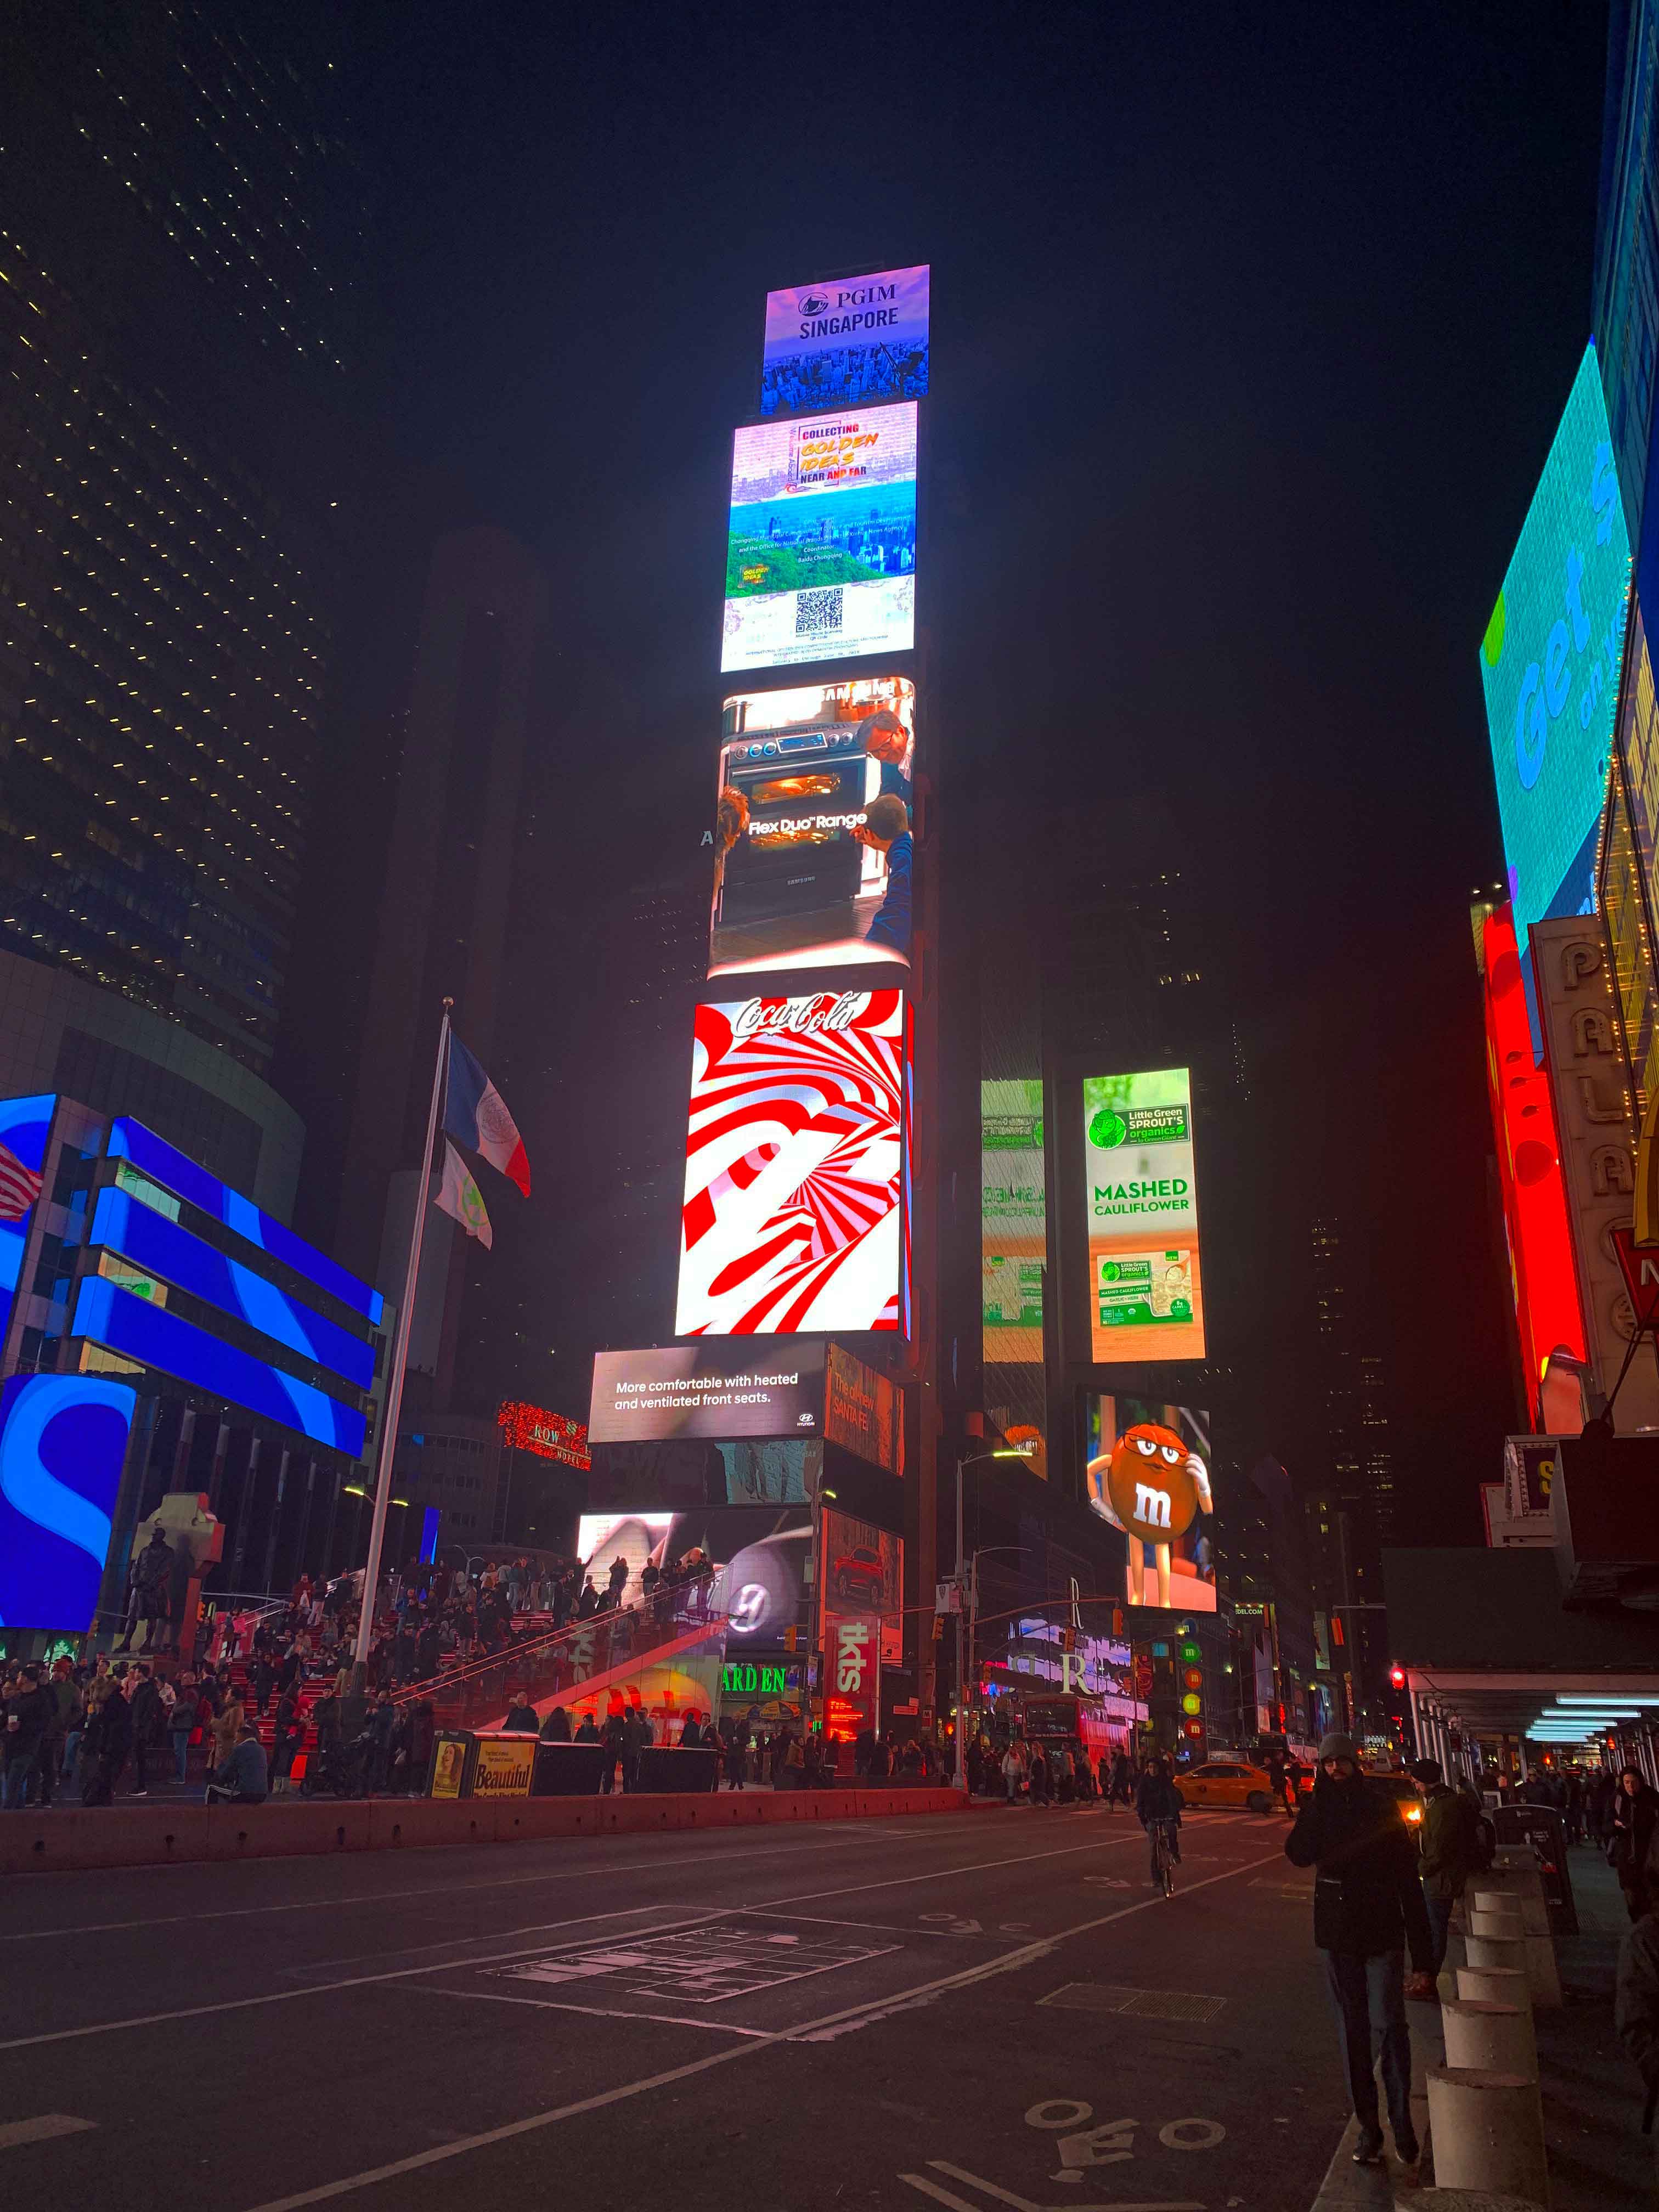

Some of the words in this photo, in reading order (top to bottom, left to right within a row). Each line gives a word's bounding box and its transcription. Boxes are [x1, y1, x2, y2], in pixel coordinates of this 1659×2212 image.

[837, 284, 896, 308] PGIM
[799, 307, 899, 339] SINGAPORE
[803, 424, 860, 440] COLLECTING
[802, 433, 879, 456] GOLDEN
[800, 452, 855, 472] IDEAS
[800, 472, 825, 484] NEAR
[827, 468, 847, 480] AND
[849, 466, 867, 476] FAR
[1515, 543, 1590, 789] Get
[748, 820, 779, 835] Flex
[816, 812, 867, 830] Range
[731, 991, 861, 1038] Coca-Cola
[1129, 1110, 1153, 1120] Little
[1154, 1108, 1182, 1118] Green
[1129, 1116, 1183, 1130] SPROUT'S
[1130, 1126, 1176, 1138] organics
[1094, 1178, 1188, 1201] MASHED
[1094, 1199, 1189, 1216] CAULIFLOWER
[616, 1381, 646, 1395] More
[648, 1376, 723, 1392] comfortable
[725, 1375, 752, 1389] with
[754, 1372, 798, 1386] heated
[835, 1373, 848, 1396] The
[614, 1398, 639, 1410] and
[640, 1393, 701, 1408] ventilated
[702, 1392, 732, 1406] front
[734, 1391, 771, 1404] seats.
[833, 1396, 857, 1426] SANTA
[859, 1410, 869, 1431] FE
[534, 1424, 560, 1444] ROW
[557, 1450, 579, 1465] HOTEL
[1133, 1482, 1172, 1528] m
[837, 1622, 870, 1693] tkts
[1059, 1654, 1094, 1695] R
[474, 1764, 531, 1790] Beautiful
